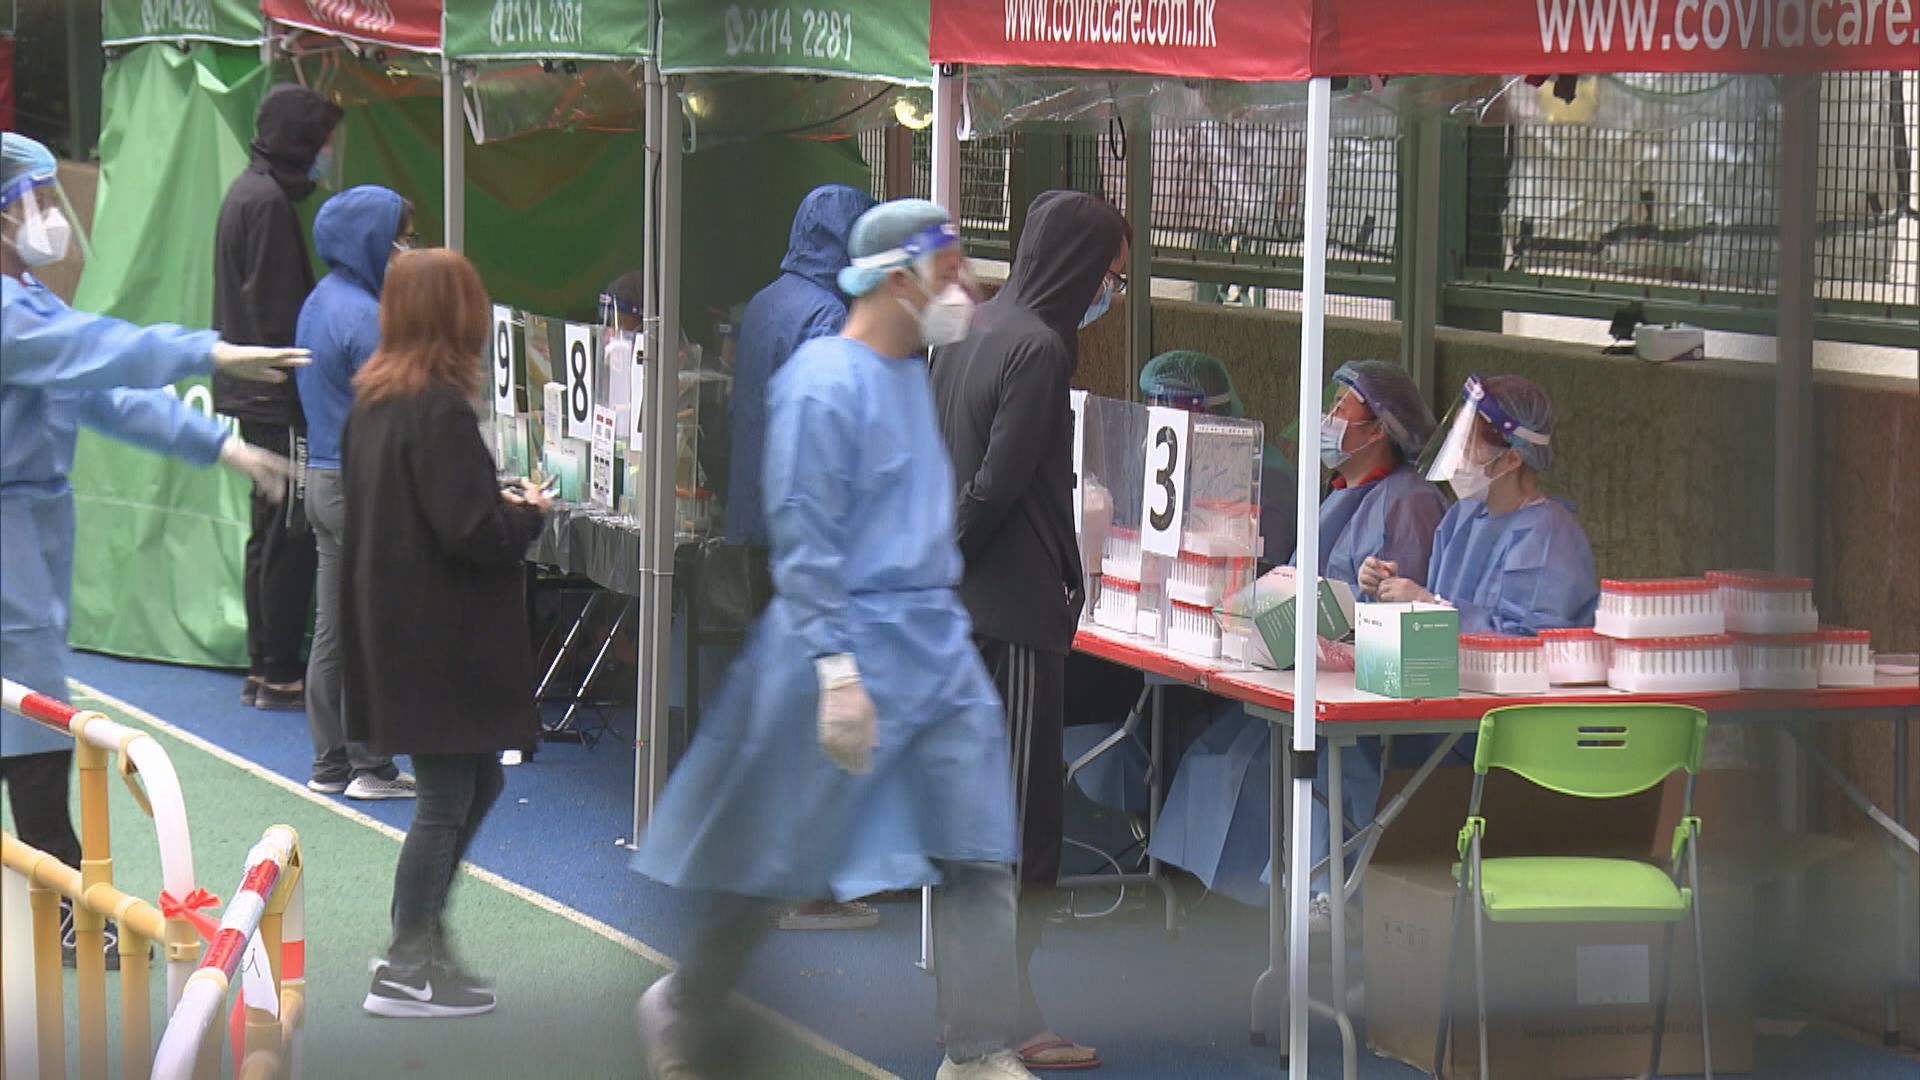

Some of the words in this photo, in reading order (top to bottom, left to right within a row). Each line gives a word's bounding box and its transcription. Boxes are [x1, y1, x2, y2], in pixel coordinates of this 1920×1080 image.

[506, 0, 543, 42] 2114
[550, 1, 583, 45] 2281
[744, 8, 792, 55] 2114
[802, 8, 852, 61] 2281
[497, 320, 510, 398] 9
[571, 340, 589, 423] 8
[1150, 426, 1178, 531] 3
